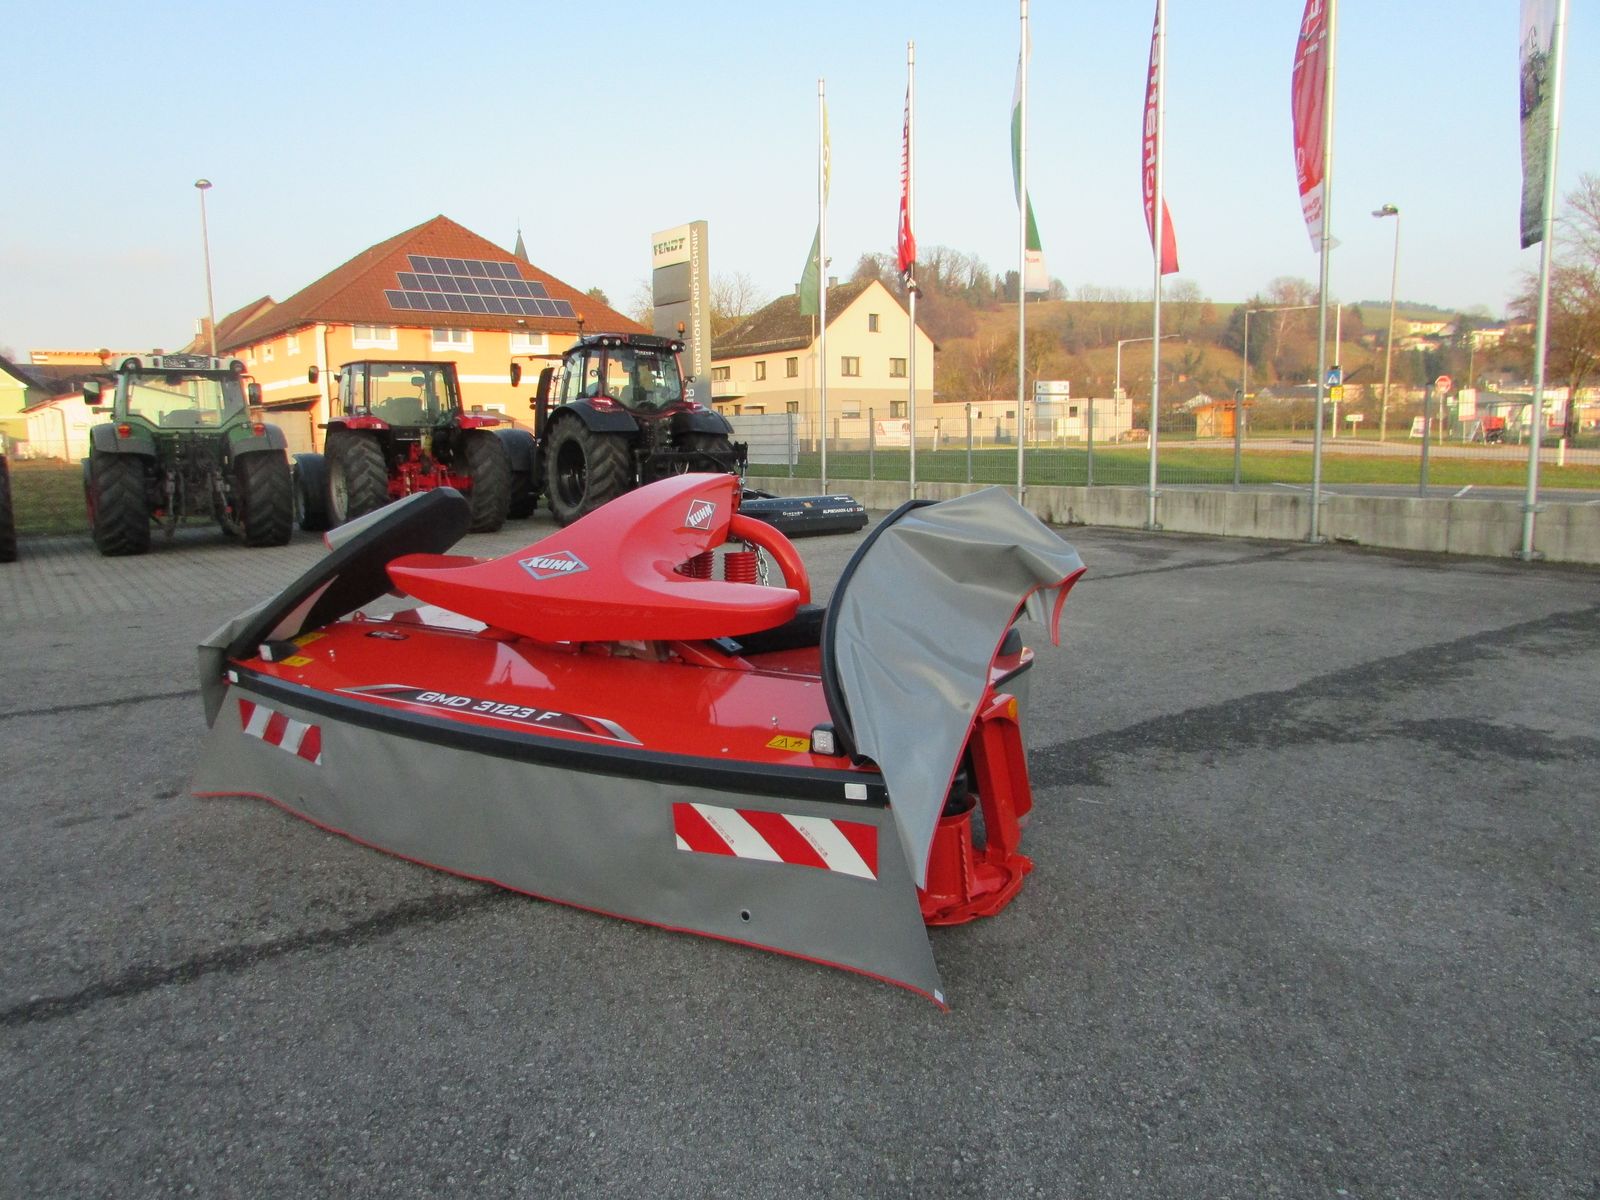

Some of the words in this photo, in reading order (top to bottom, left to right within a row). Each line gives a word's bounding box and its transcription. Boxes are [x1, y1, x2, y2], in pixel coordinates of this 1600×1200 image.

[653, 237, 685, 256] FENDT
[691, 228, 700, 318] LANDTECHNIK
[688, 503, 712, 527] KUHN
[527, 557, 579, 571] KUHN
[416, 691, 472, 707] GMD
[472, 700, 535, 718] 3123
[535, 711, 562, 721] F
